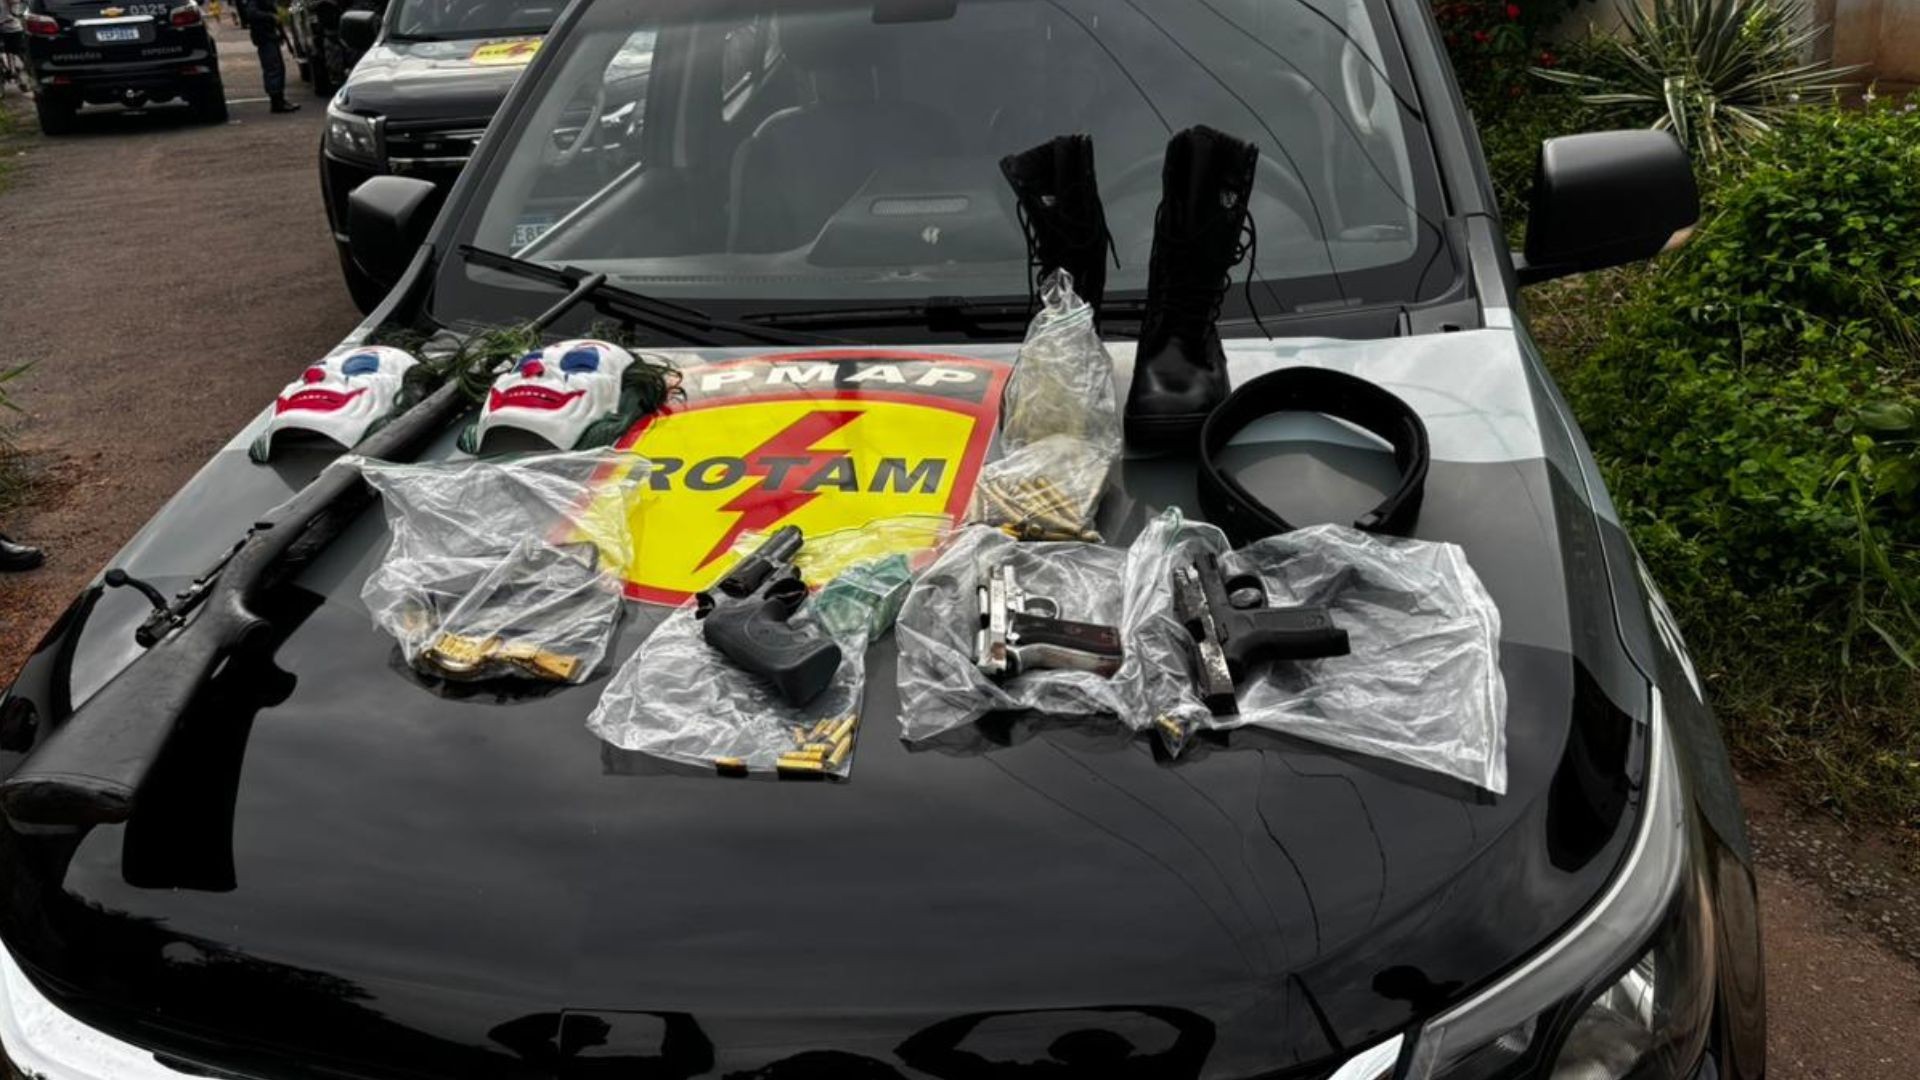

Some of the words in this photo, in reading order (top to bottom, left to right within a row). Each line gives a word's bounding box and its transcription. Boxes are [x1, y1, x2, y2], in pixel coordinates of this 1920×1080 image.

[130, 4, 167, 16] 0325
[701, 361, 978, 392] PMAP
[624, 456, 948, 494] ROTAM
